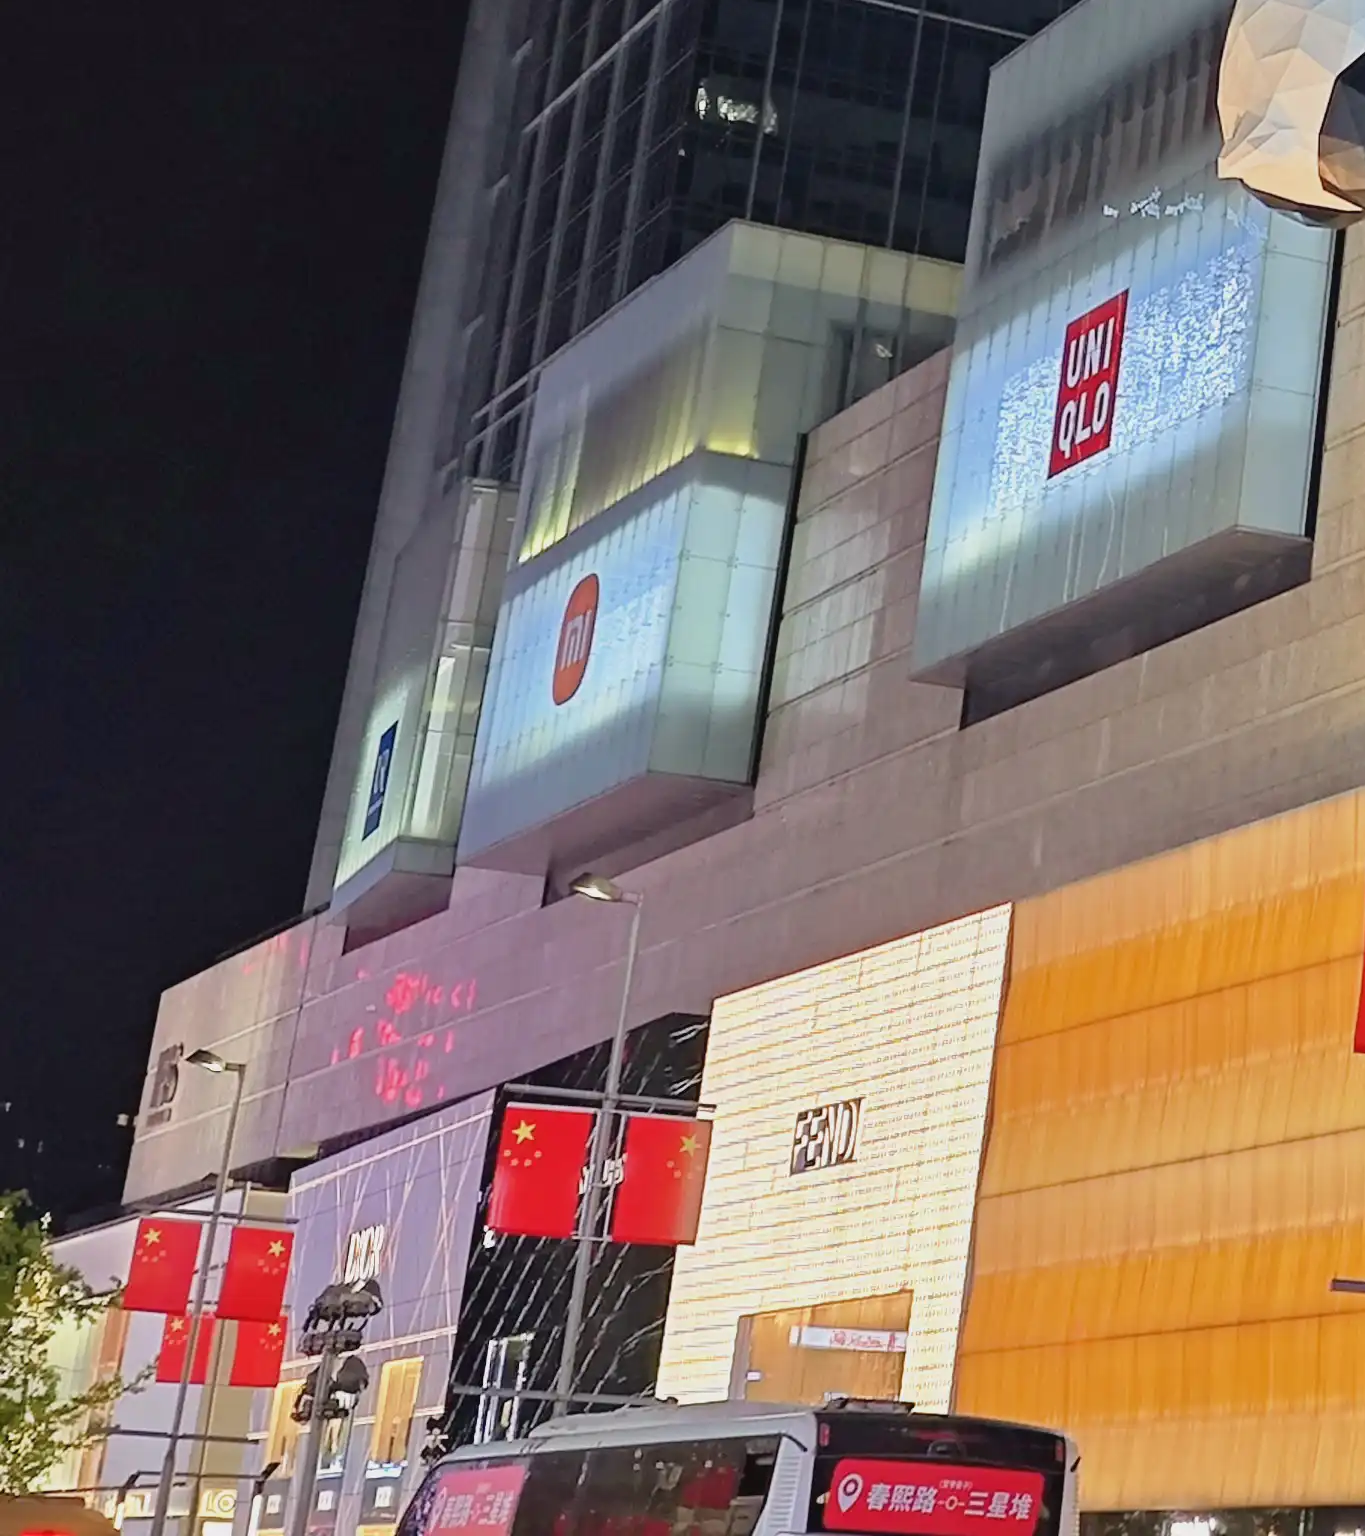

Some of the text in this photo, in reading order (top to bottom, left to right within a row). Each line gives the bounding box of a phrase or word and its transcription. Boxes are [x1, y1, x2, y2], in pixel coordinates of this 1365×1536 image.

[1066, 316, 1115, 389] UNI
[1058, 380, 1110, 460] QLO
[790, 1097, 865, 1175] FENDI
[866, 1482, 1034, 1521] 春熙路 三星堆
